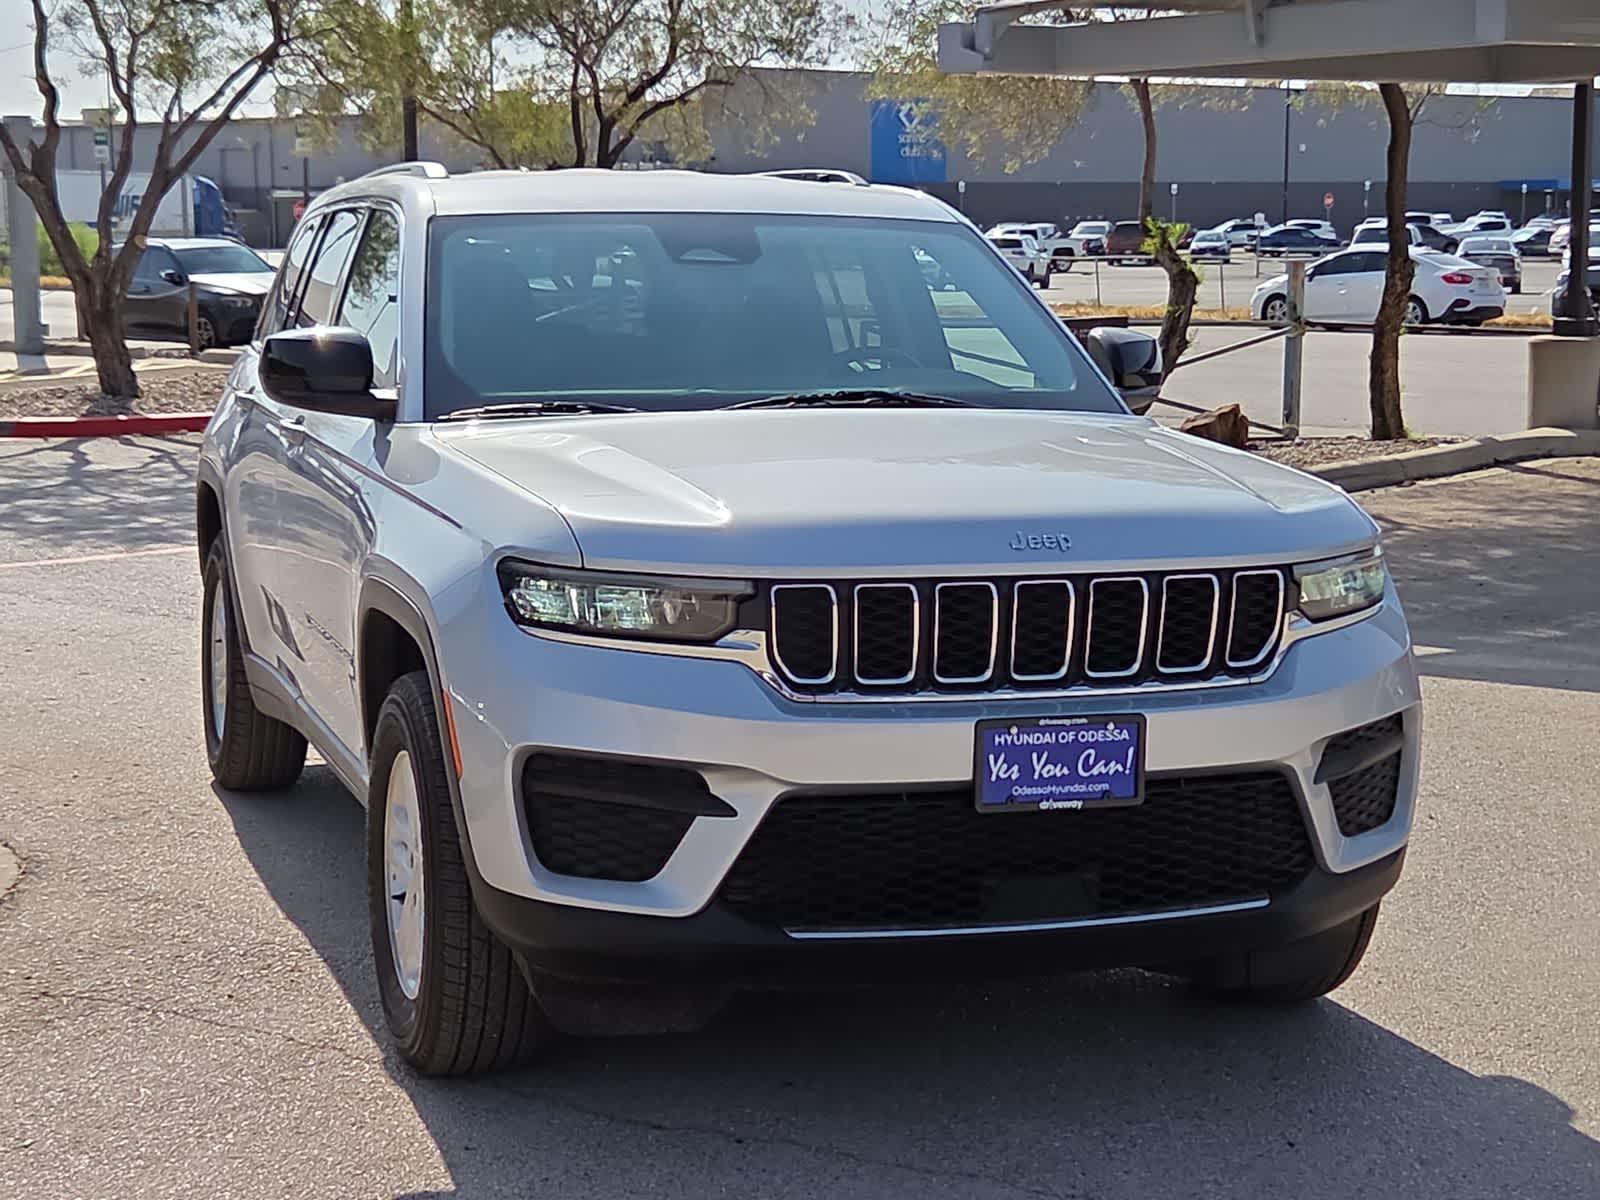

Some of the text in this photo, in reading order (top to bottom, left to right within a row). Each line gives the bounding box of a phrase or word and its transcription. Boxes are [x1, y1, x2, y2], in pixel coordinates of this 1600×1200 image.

[1008, 530, 1072, 553] Jeep
[994, 729, 1130, 746] HYUNDAI OF ODESSA
[988, 746, 1135, 782] Yes You Can!
[1011, 782, 1110, 796] OdessaHyundai.com
[1039, 798, 1084, 810] driveway
